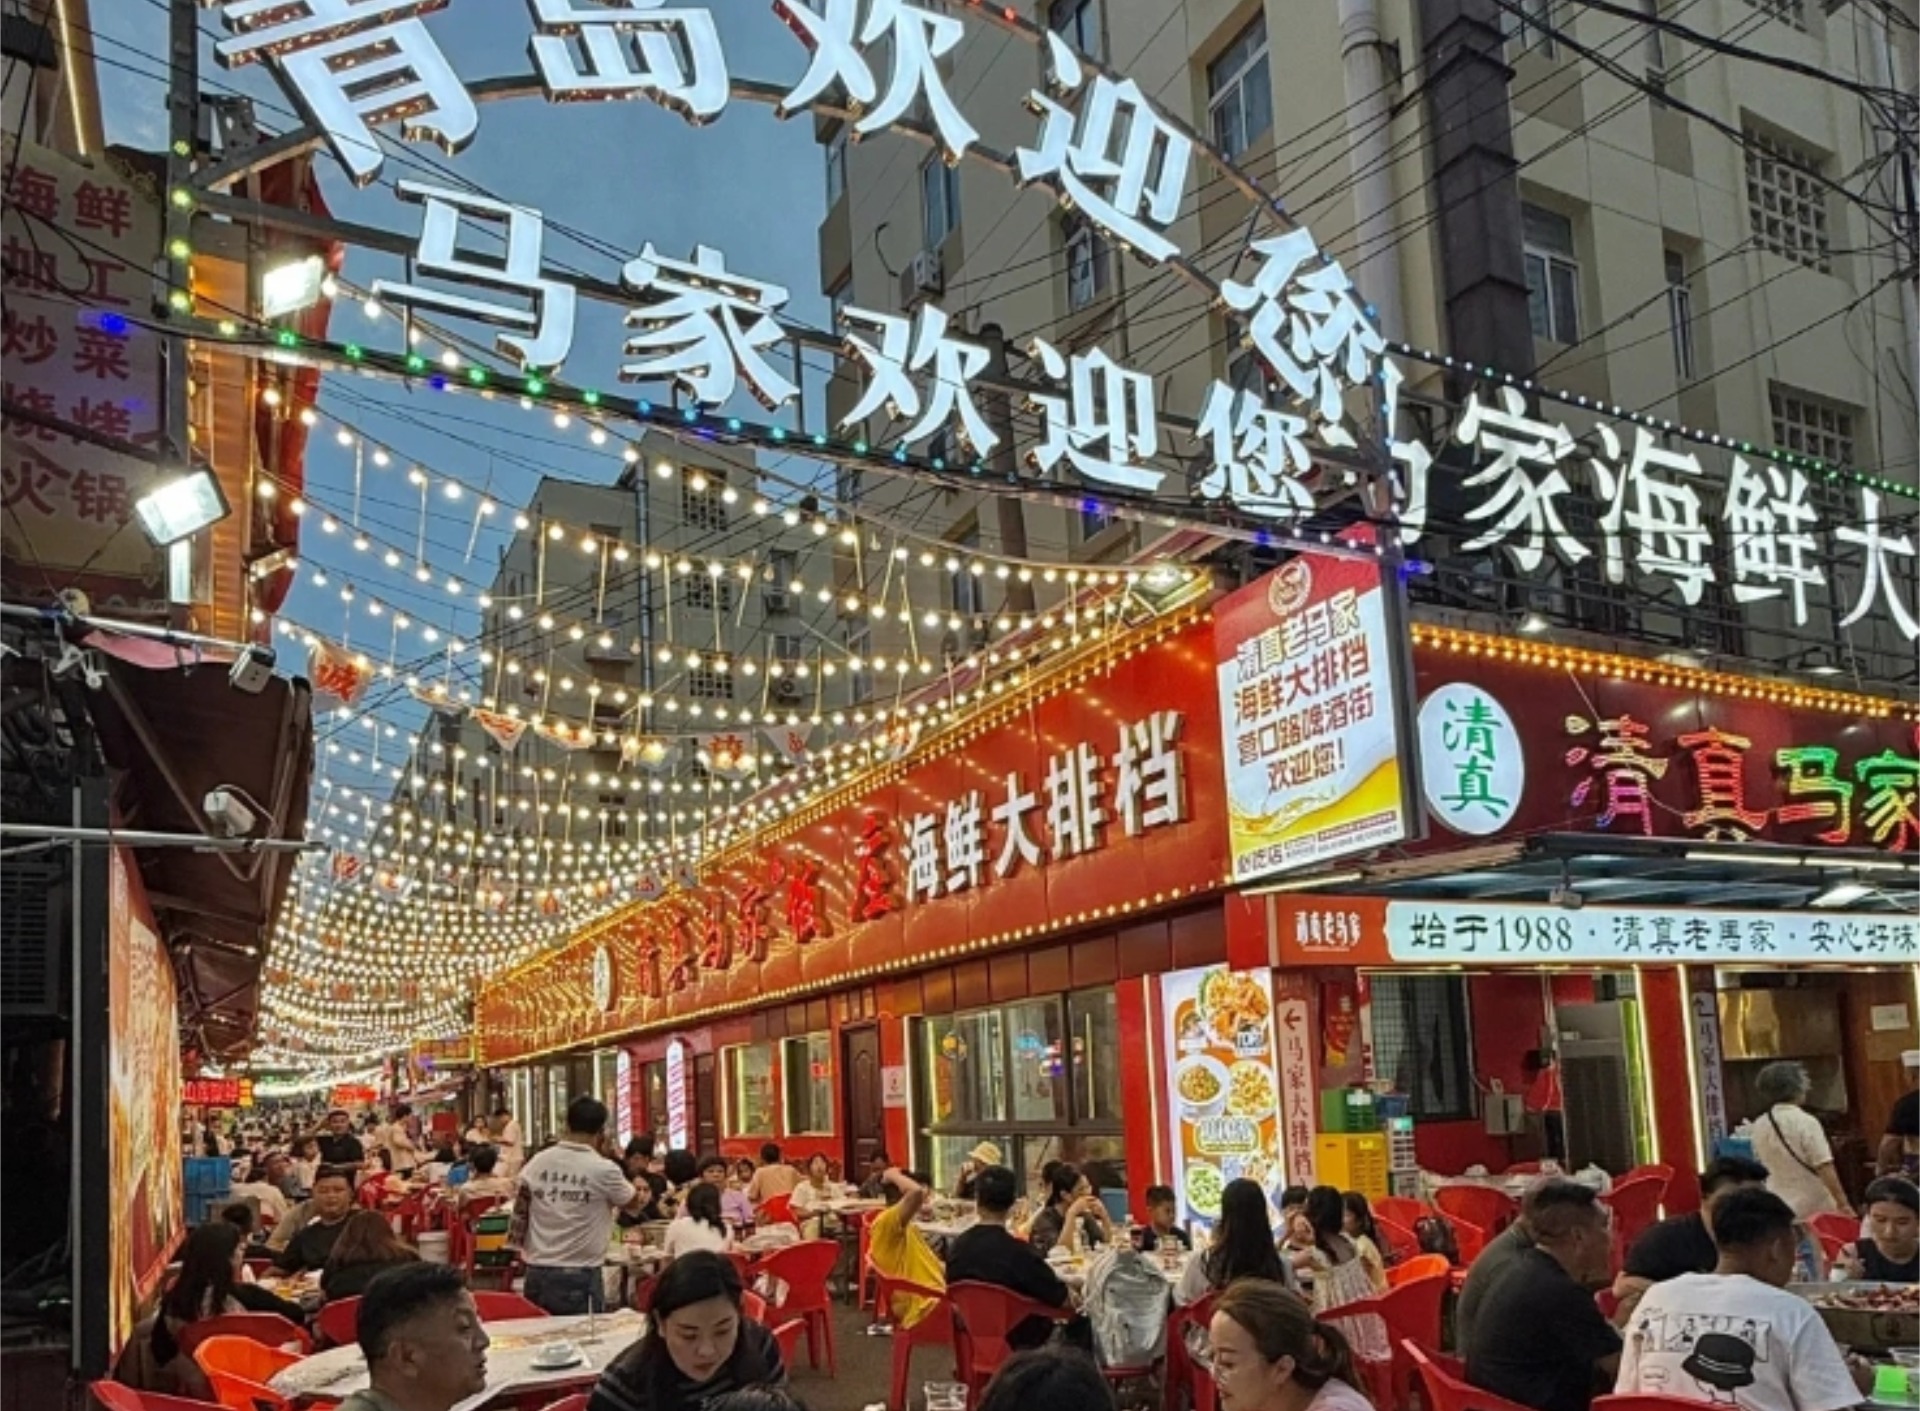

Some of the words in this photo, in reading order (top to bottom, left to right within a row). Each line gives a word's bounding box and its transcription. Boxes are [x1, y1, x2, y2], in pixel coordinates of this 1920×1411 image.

[4, 160, 133, 239] 海鲜
[215, 0, 1388, 422] 青岛欢迎您
[1, 233, 131, 307] 加工
[1, 310, 131, 382] 炒菜
[372, 178, 1316, 518] 马家欢迎您
[1, 380, 133, 447] 烧烤
[1, 458, 131, 526] 火锅
[1232, 633, 1370, 728] 海鲜大排档
[1237, 588, 1360, 684] 清真老马家
[1236, 683, 1374, 767] 营口路啤酒街
[1441, 696, 1510, 818] 清真
[902, 709, 1190, 904] 海鲜大排档
[1565, 714, 1920, 853] 清真马家
